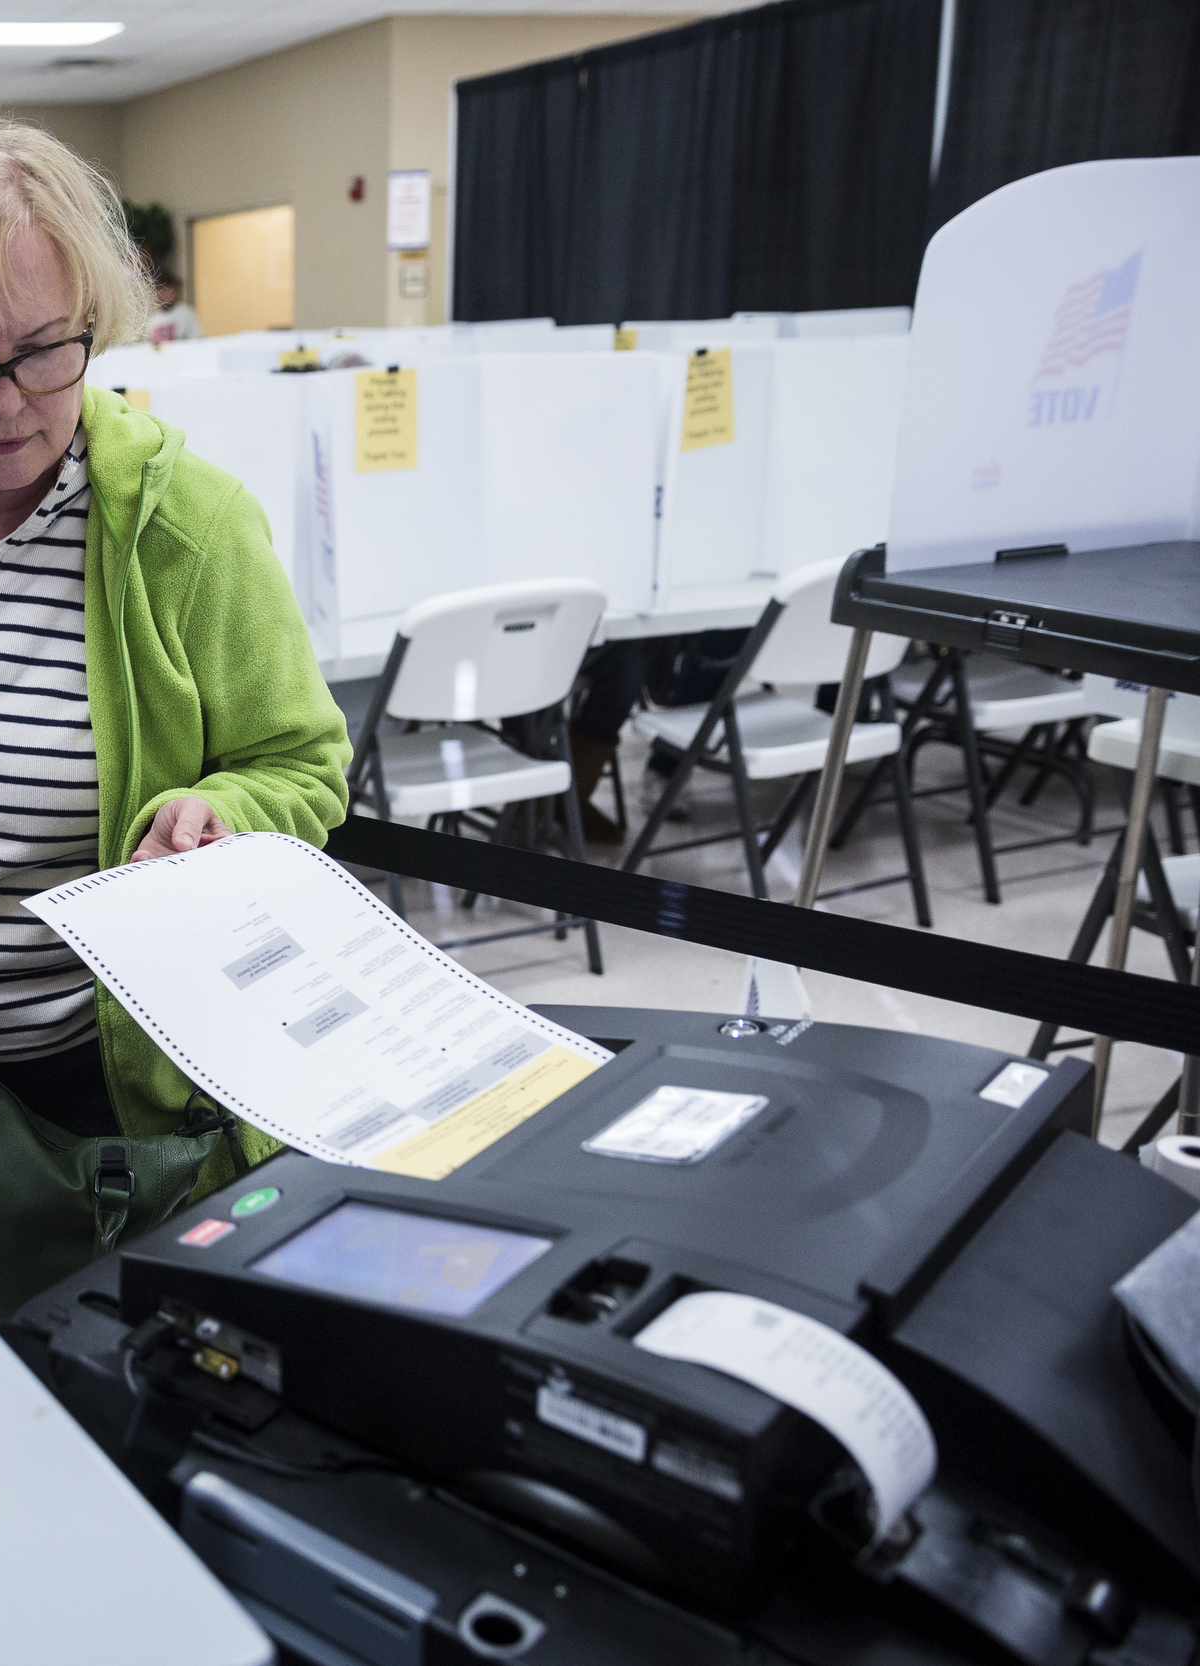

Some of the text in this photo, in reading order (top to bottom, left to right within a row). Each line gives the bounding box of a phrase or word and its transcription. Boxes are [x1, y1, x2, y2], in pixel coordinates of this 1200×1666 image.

[266, 955, 287, 967] Tennessee
[237, 968, 252, 977] District
[254, 966, 267, 974] House
